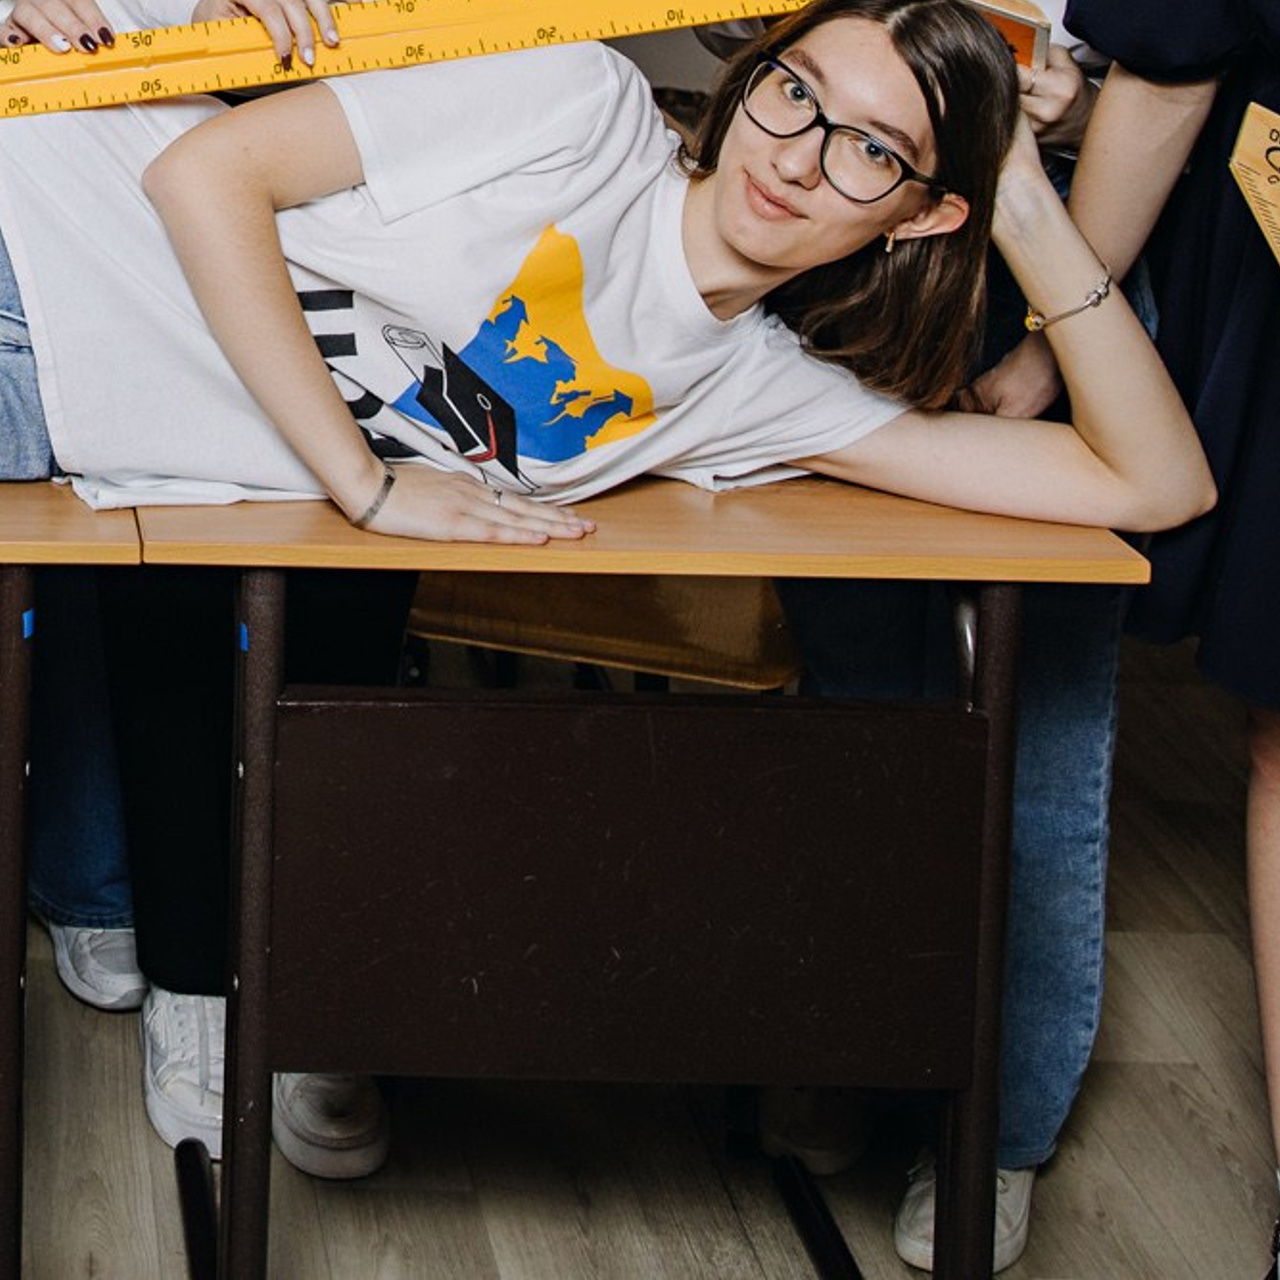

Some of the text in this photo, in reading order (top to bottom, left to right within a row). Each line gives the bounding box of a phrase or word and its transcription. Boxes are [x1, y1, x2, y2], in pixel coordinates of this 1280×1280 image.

[667, 9, 685, 22] 10
[0, 51, 20, 65] 40
[132, 34, 153, 48] 50
[394, 0, 415, 14] 70
[537, 26, 556, 40] 20
[405, 43, 425, 57] 30
[141, 78, 162, 93] 50
[8, 96, 29, 110] 60
